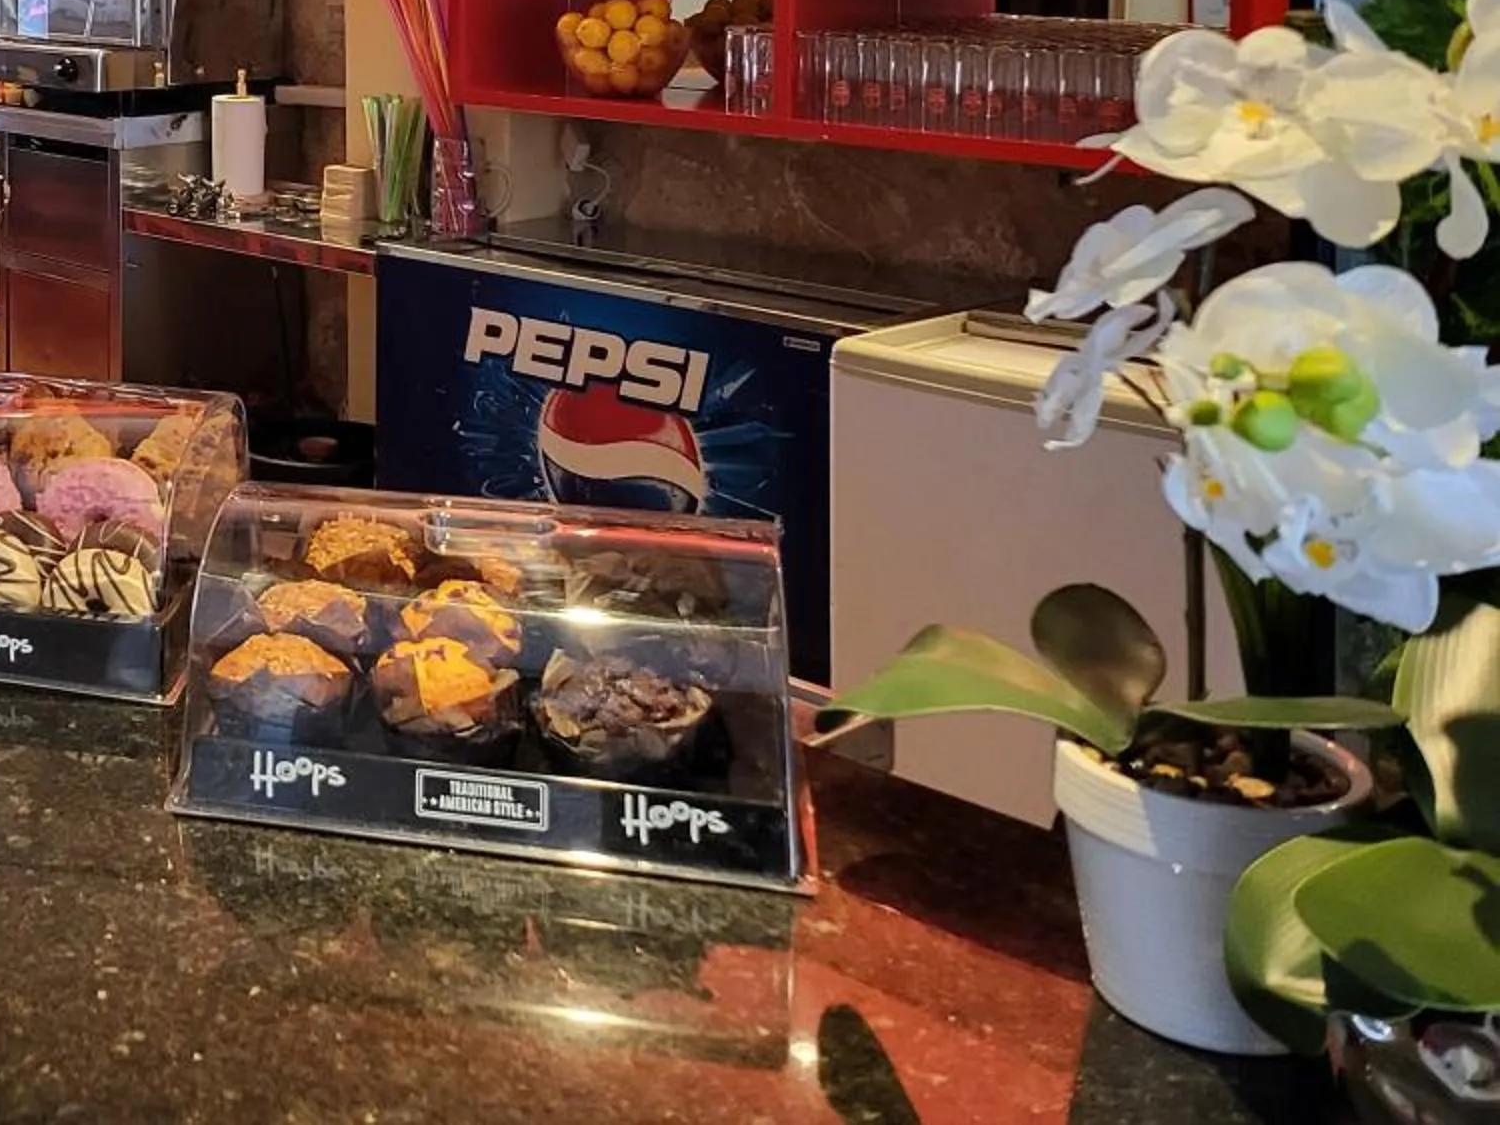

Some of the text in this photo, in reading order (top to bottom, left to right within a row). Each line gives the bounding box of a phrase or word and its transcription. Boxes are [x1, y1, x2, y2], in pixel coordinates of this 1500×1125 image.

[464, 307, 709, 412] PEPSI
[250, 750, 346, 798] Hoops
[620, 793, 729, 846] Hoops
